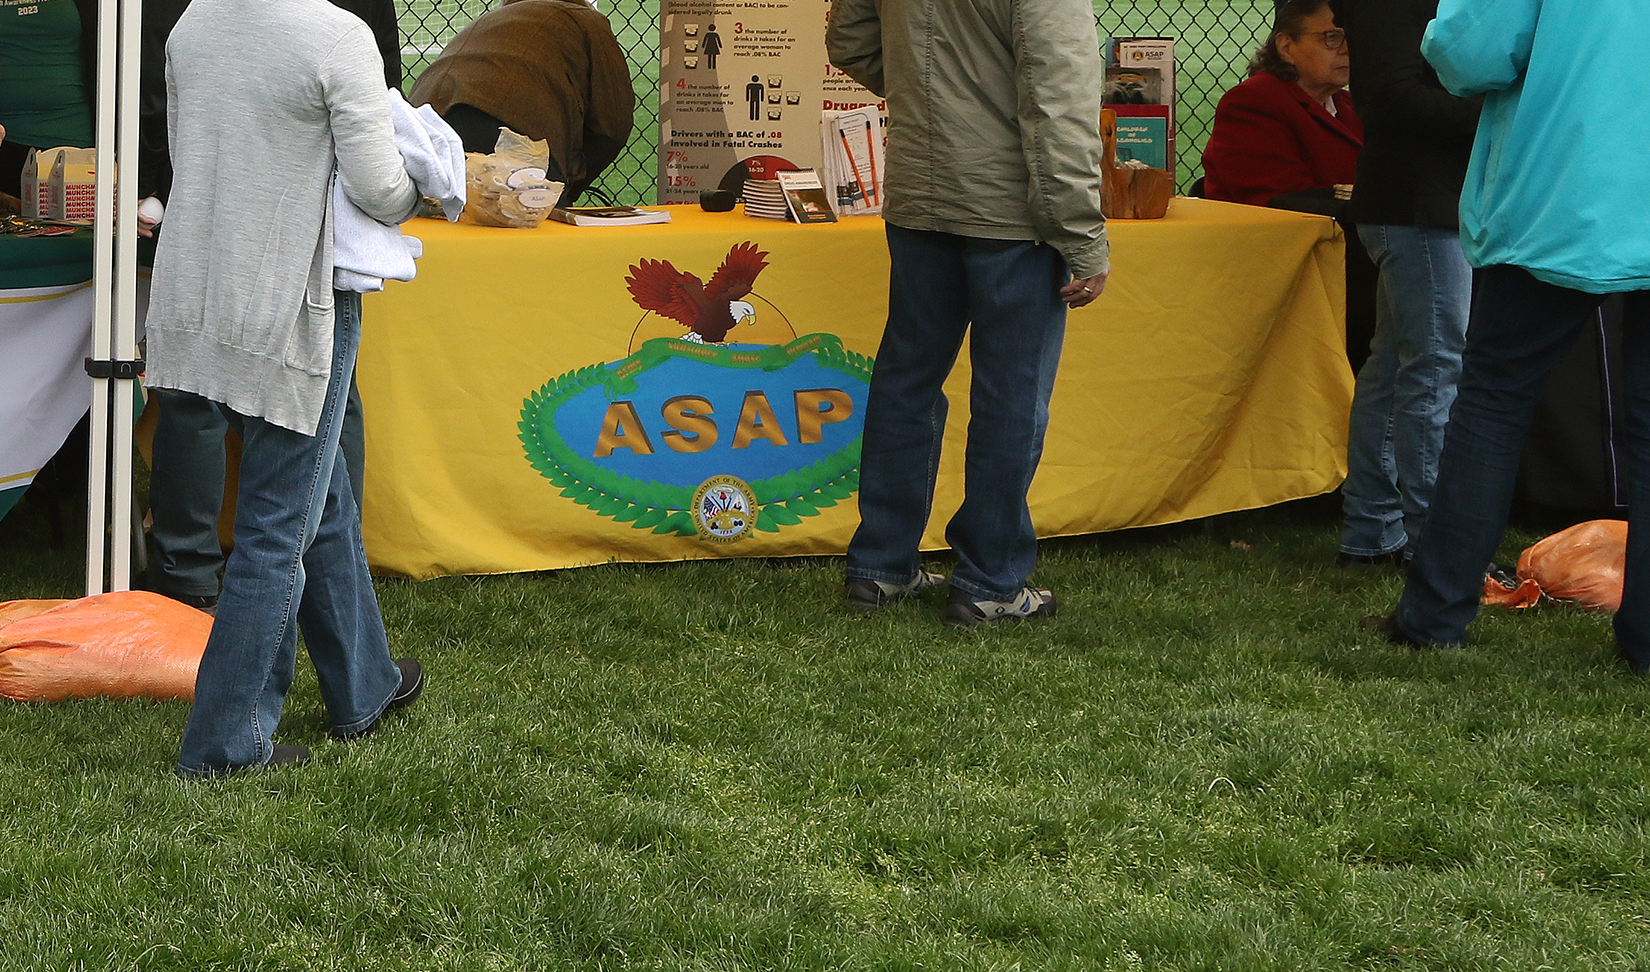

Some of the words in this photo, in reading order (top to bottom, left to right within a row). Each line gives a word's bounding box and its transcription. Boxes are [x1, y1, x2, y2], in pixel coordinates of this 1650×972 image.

[17, 5, 39, 16] 2023
[734, 22, 743, 35] 3
[676, 78, 686, 90] 4
[671, 130, 703, 138] Drivers
[706, 130, 725, 138] with
[767, 131, 782, 139] .08
[670, 140, 709, 148] Involved
[712, 140, 720, 148] in
[723, 140, 745, 148] Fatal
[748, 140, 783, 148] Crashes
[667, 151, 688, 162] 7%
[667, 176, 696, 187] 15%
[593, 387, 854, 458] ASAP
